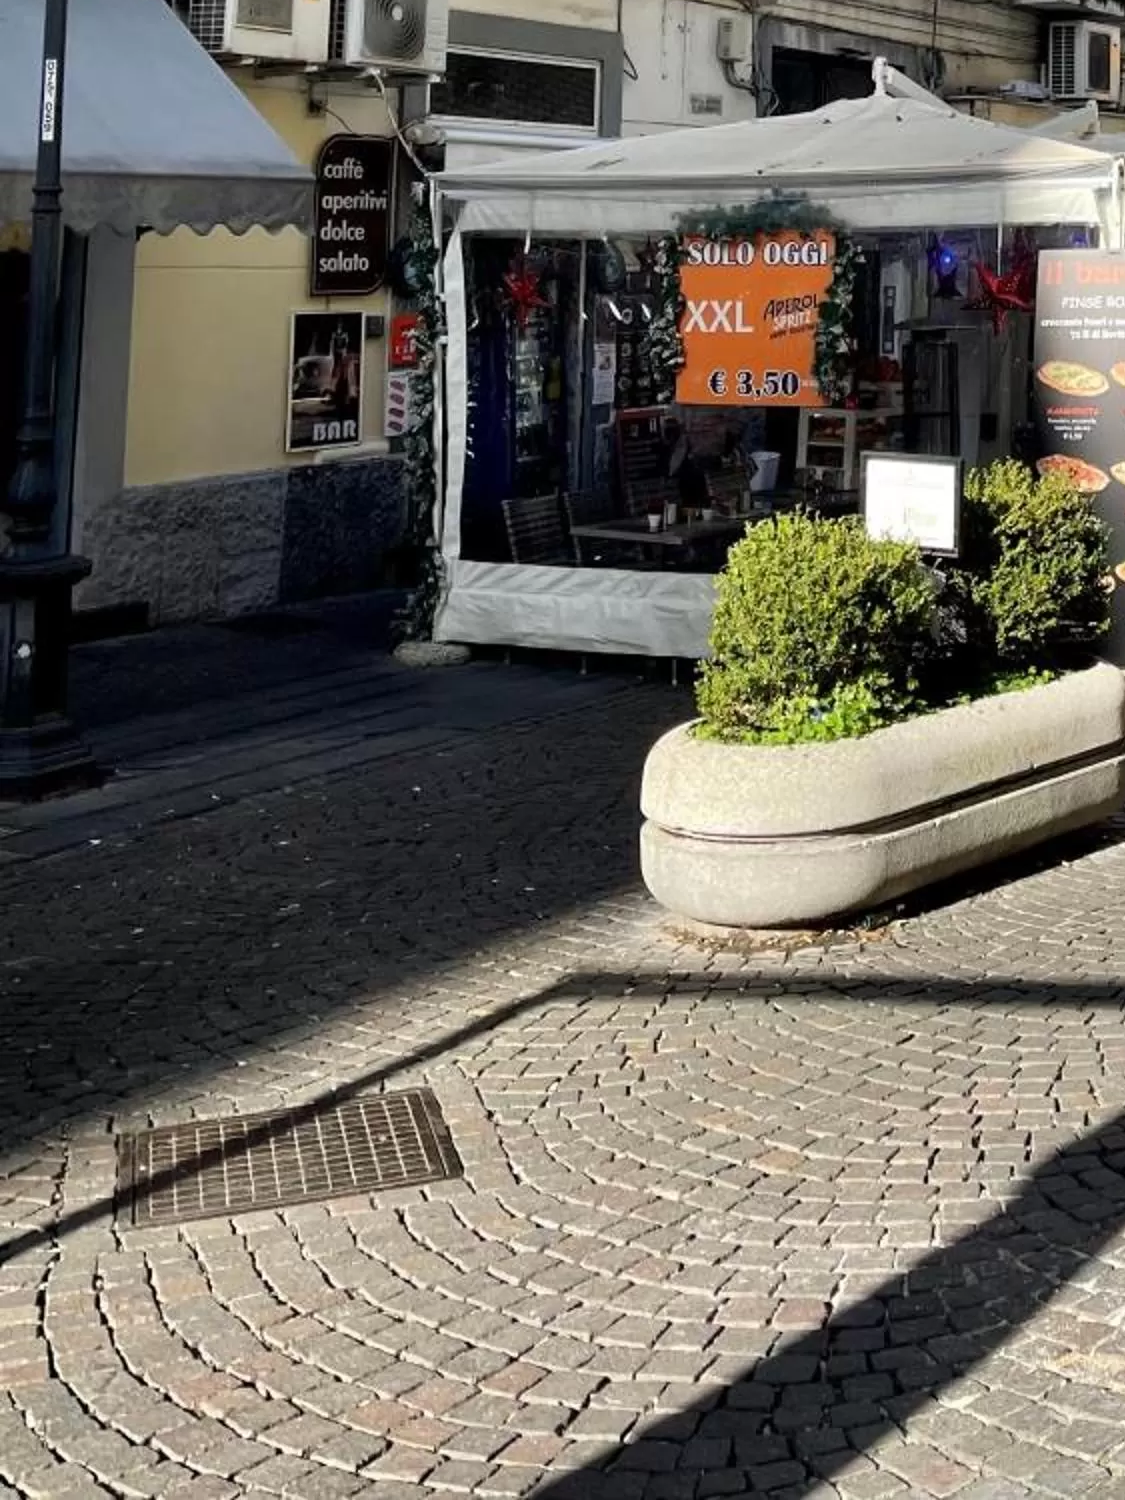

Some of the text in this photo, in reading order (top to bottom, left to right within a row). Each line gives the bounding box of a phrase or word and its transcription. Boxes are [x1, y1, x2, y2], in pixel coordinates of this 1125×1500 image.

[323, 157, 365, 180] caffè
[321, 189, 388, 215] aperitivi
[320, 219, 366, 241] dolce
[318, 250, 370, 273] salato
[686, 240, 829, 266] SOLO OGGI
[684, 299, 755, 334] XXL
[709, 367, 803, 398] € 3,50
[311, 419, 358, 443] BAR
